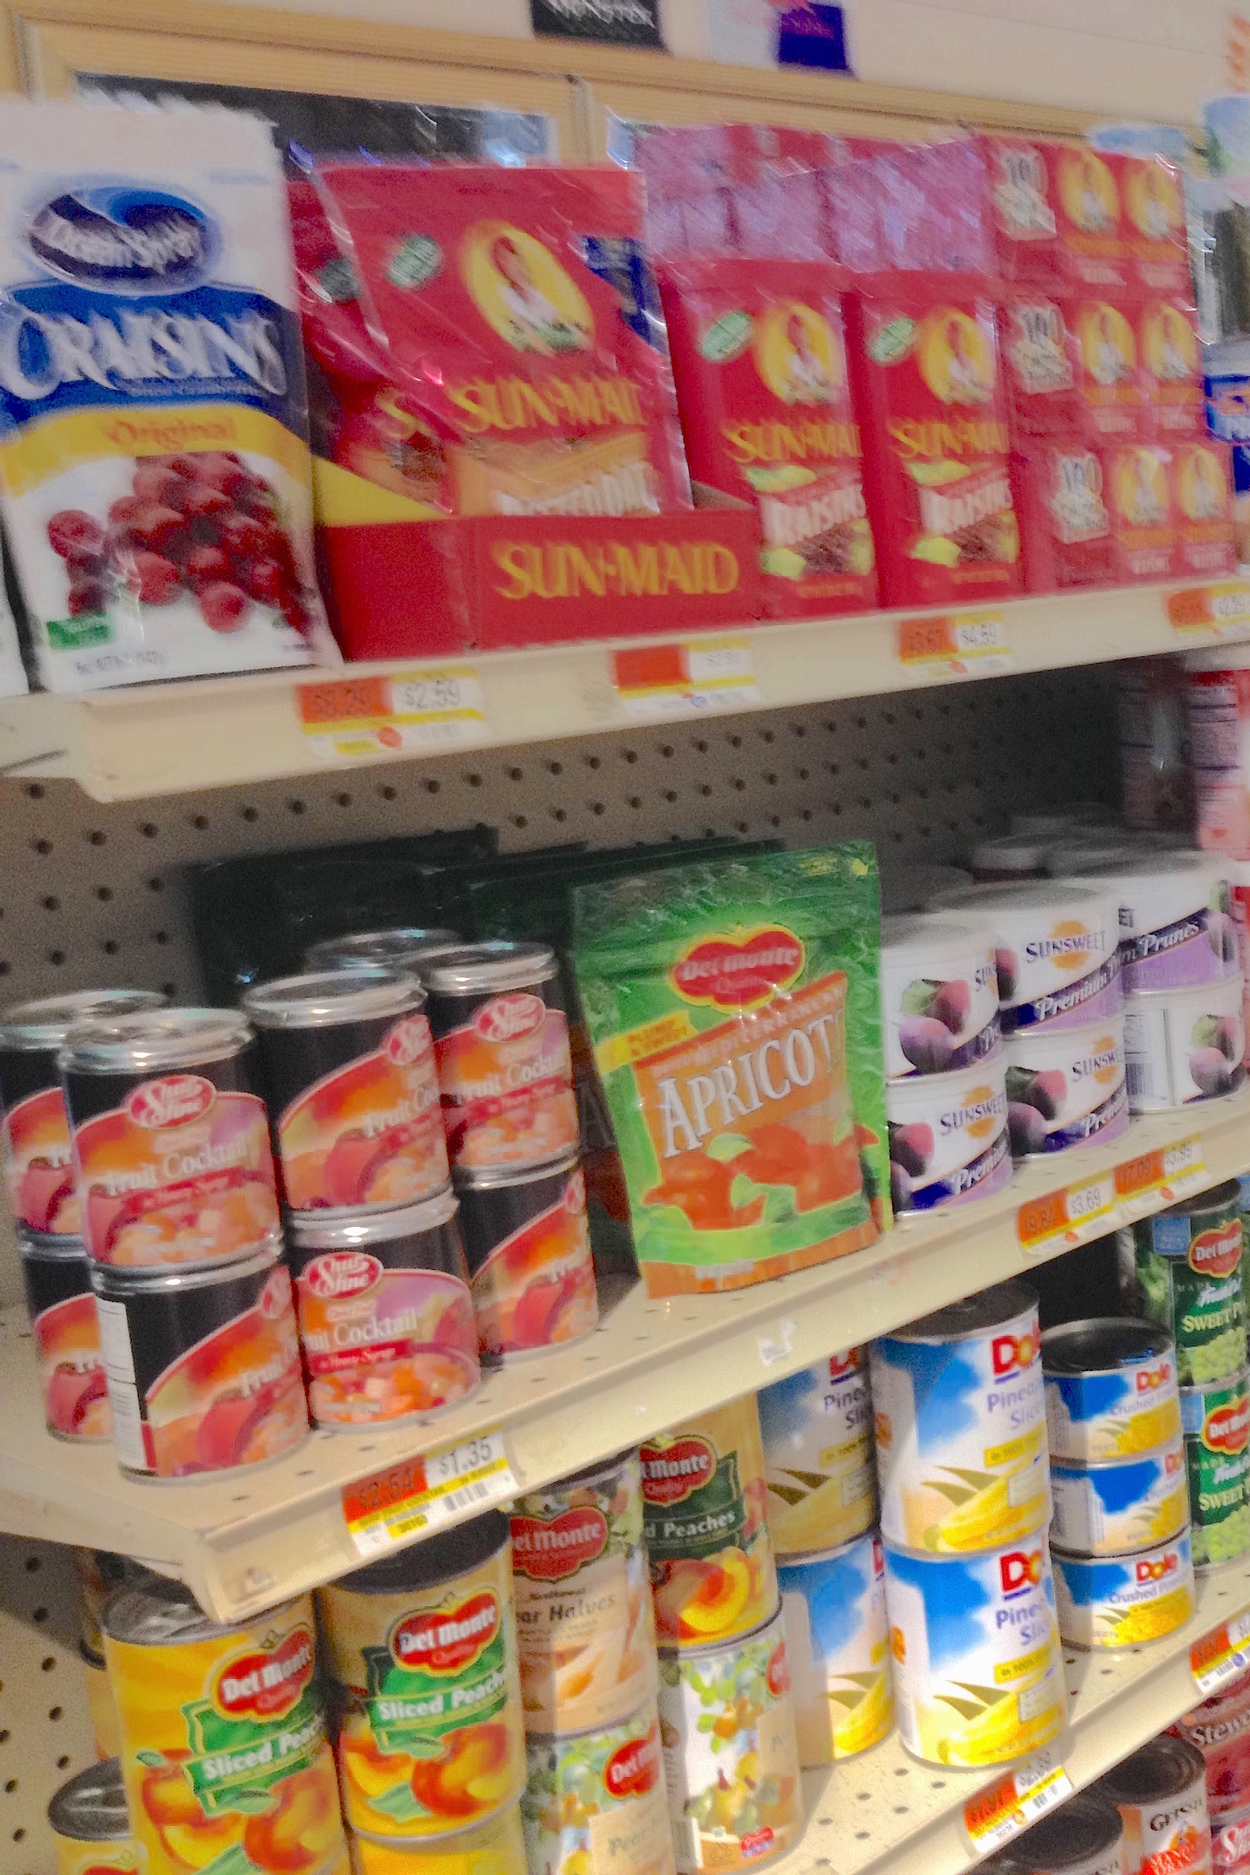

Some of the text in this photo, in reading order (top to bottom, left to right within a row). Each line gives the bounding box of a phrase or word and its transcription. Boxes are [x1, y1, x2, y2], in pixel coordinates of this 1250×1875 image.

[107, 414, 238, 450] Original
[1026, 931, 1107, 965] SUNSWEET
[1138, 921, 1201, 957] Prunes
[680, 961, 720, 981] Del
[333, 1308, 418, 1346] Cocktail
[438, 1436, 493, 1477] $1.35
[536, 1522, 602, 1551] Monte
[665, 1509, 736, 1539] Peaches
[1135, 1552, 1179, 1582] Dole
[549, 1591, 617, 1621] Halves
[1109, 1580, 1154, 1605] Crushed
[399, 1629, 436, 1655] Del
[438, 1604, 496, 1647] Monte
[220, 1671, 261, 1704] Del
[377, 1693, 444, 1721] Sliced
[202, 1742, 273, 1781] Sliced
